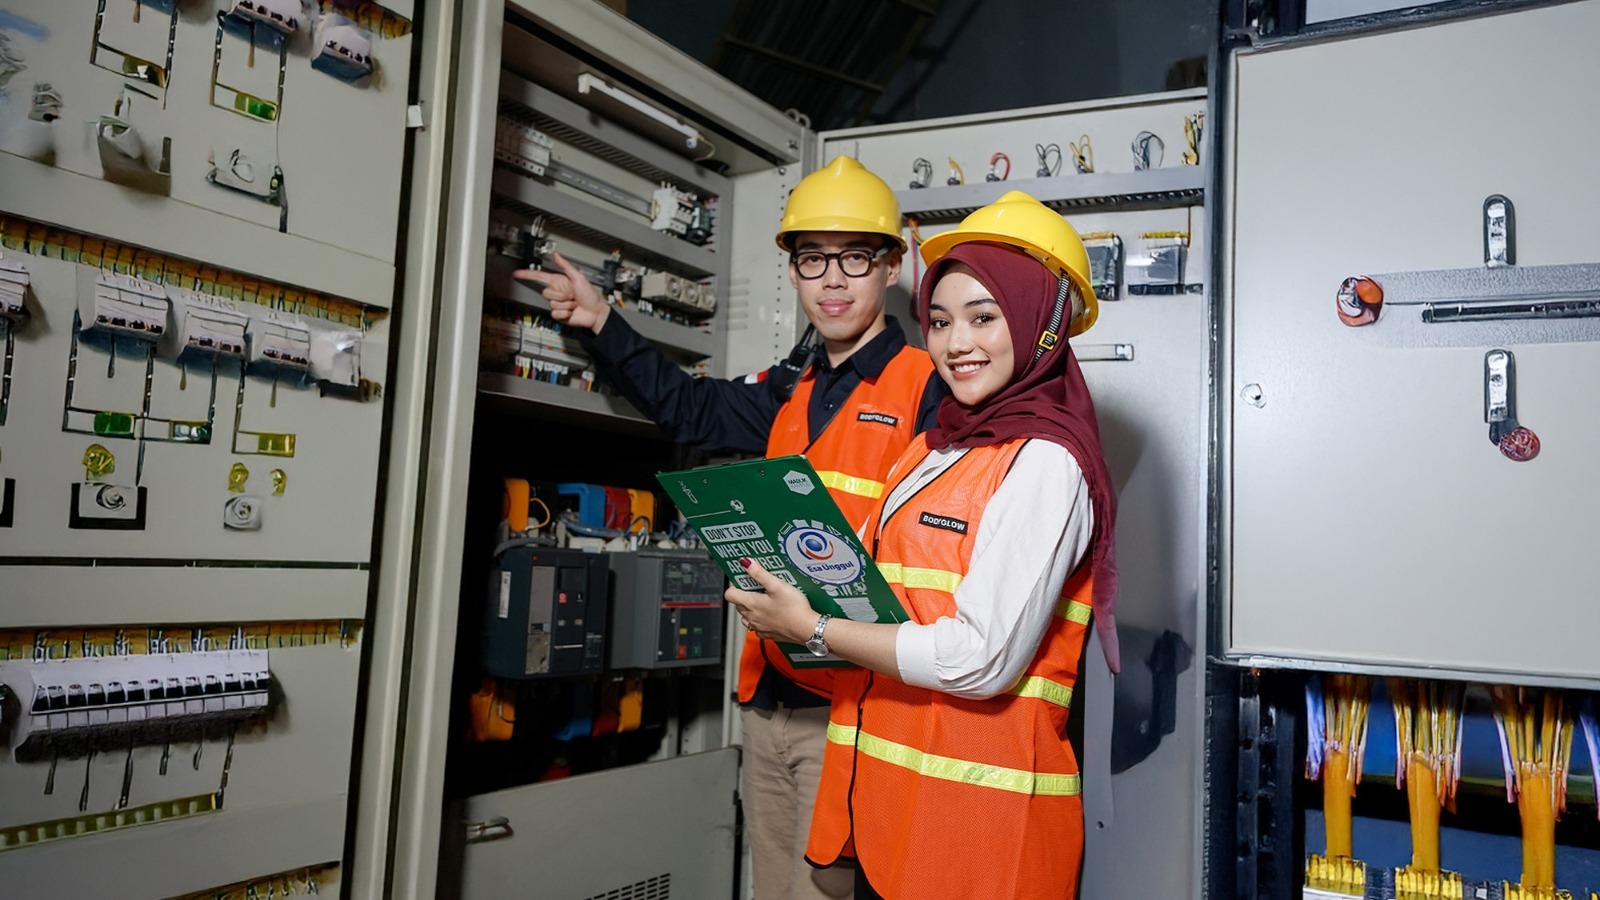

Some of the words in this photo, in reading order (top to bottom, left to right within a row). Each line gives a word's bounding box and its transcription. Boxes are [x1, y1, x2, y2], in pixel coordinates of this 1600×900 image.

[705, 527, 734, 540] DON'T
[732, 524, 757, 537] STOP
[712, 541, 751, 558] WHEN
[746, 539, 775, 554] YOU
[725, 559, 744, 574] AR
[806, 565, 823, 573] Esa
[822, 560, 855, 571] Unggul
[738, 576, 762, 588] STO
